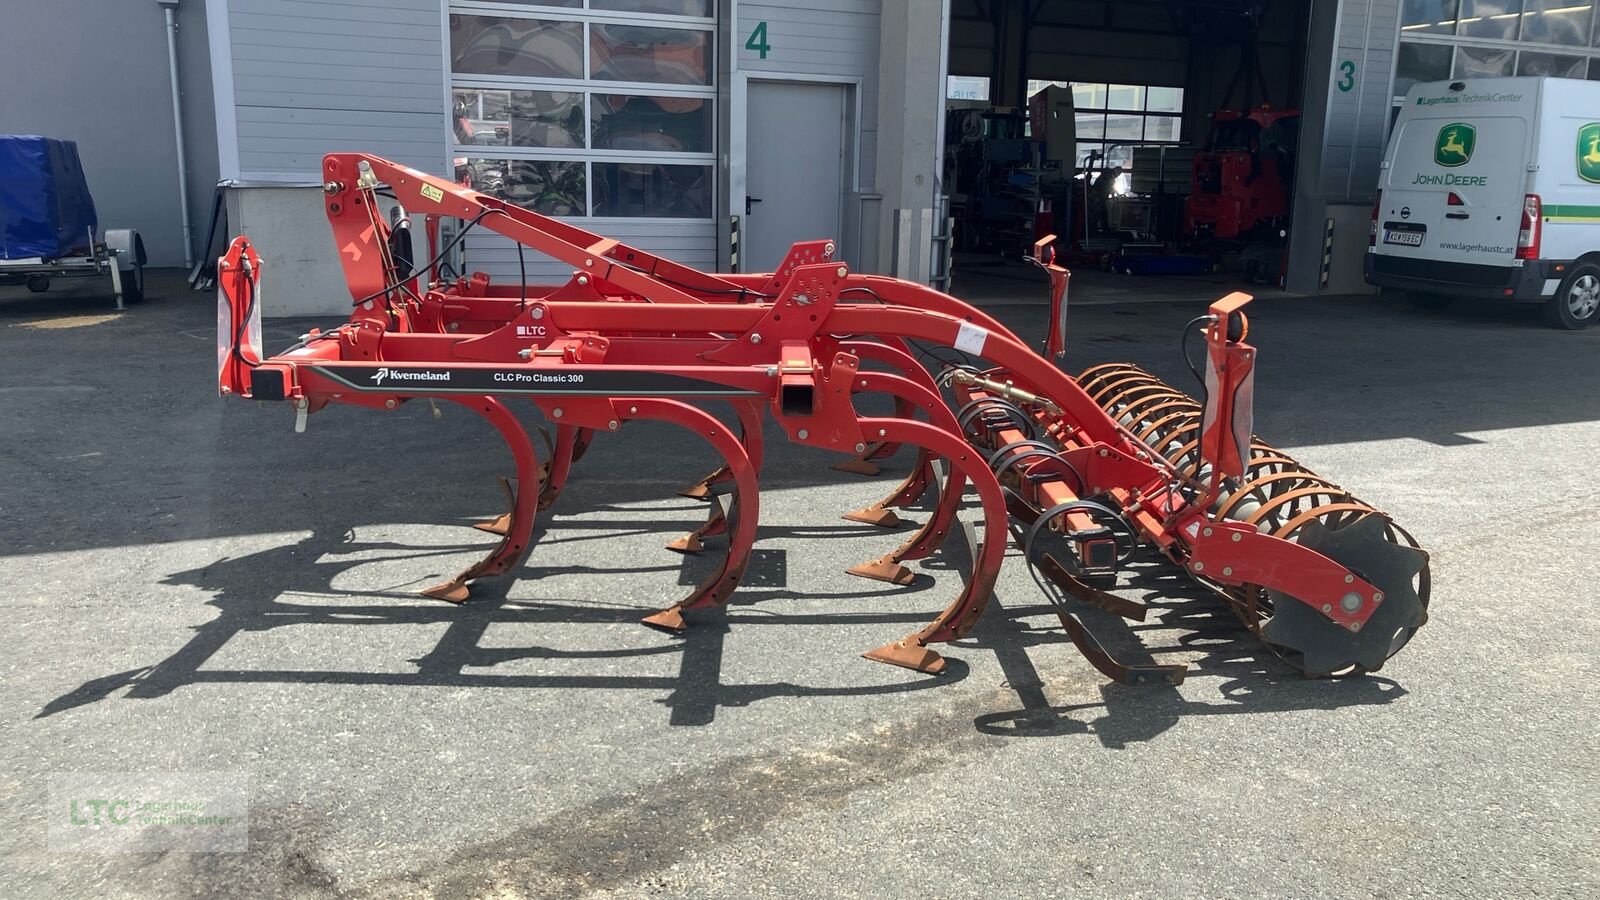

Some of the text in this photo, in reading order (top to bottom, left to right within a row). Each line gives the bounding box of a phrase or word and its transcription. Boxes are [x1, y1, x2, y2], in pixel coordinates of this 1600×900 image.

[745, 21, 771, 59] 4
[1337, 60, 1355, 92] 3
[1423, 92, 1523, 106] Lagerhaus TechnikCenter
[1412, 172, 1488, 186] JOHN DEERE
[1440, 242, 1514, 255] www.lagerhaustc.at
[526, 326, 546, 335] LTC
[390, 370, 450, 381] Kverneland
[494, 373, 584, 383] CLC Pro Classic 300
